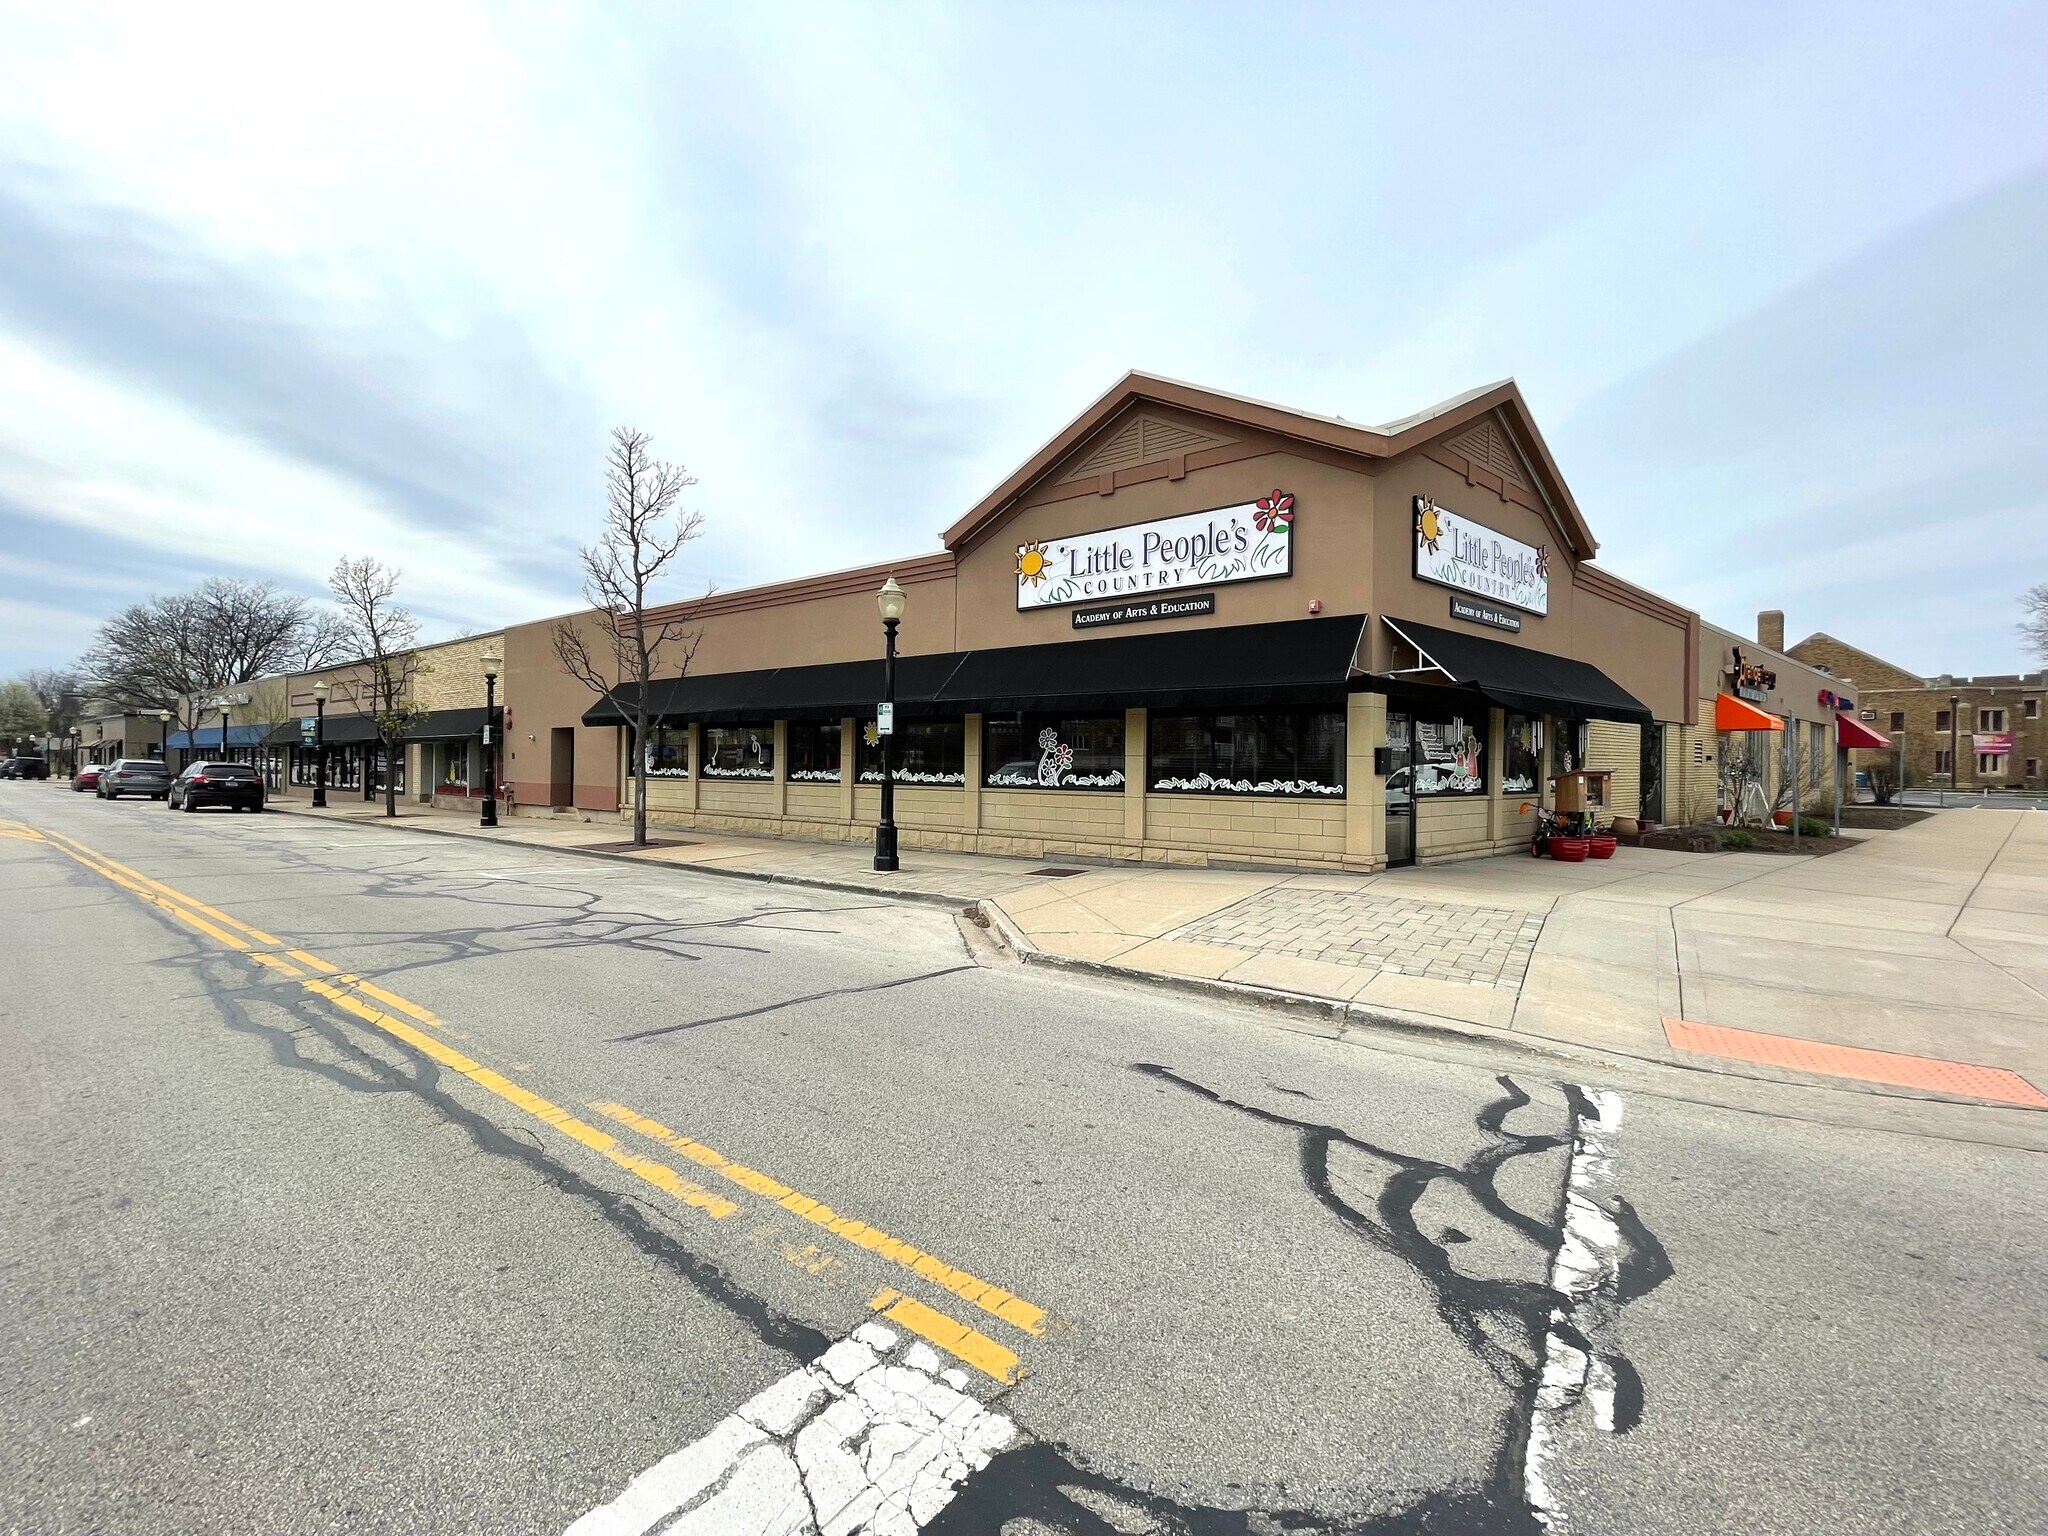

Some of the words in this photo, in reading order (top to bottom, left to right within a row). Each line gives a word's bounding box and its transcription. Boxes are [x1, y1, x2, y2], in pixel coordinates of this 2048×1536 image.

[1069, 541, 1133, 578] Little
[1142, 518, 1249, 569] People's
[1453, 528, 1489, 571] Little
[1491, 540, 1536, 590] People's
[1084, 568, 1186, 595] COUNTRY
[1461, 569, 1511, 599] COUNTRY
[1075, 613, 1111, 624] ACADEMY
[1112, 611, 1123, 620] OF
[1125, 607, 1148, 618] ARTS
[1149, 604, 1158, 616] &
[1160, 600, 1210, 614] EDUCATION
[1493, 612, 1498, 623] &
